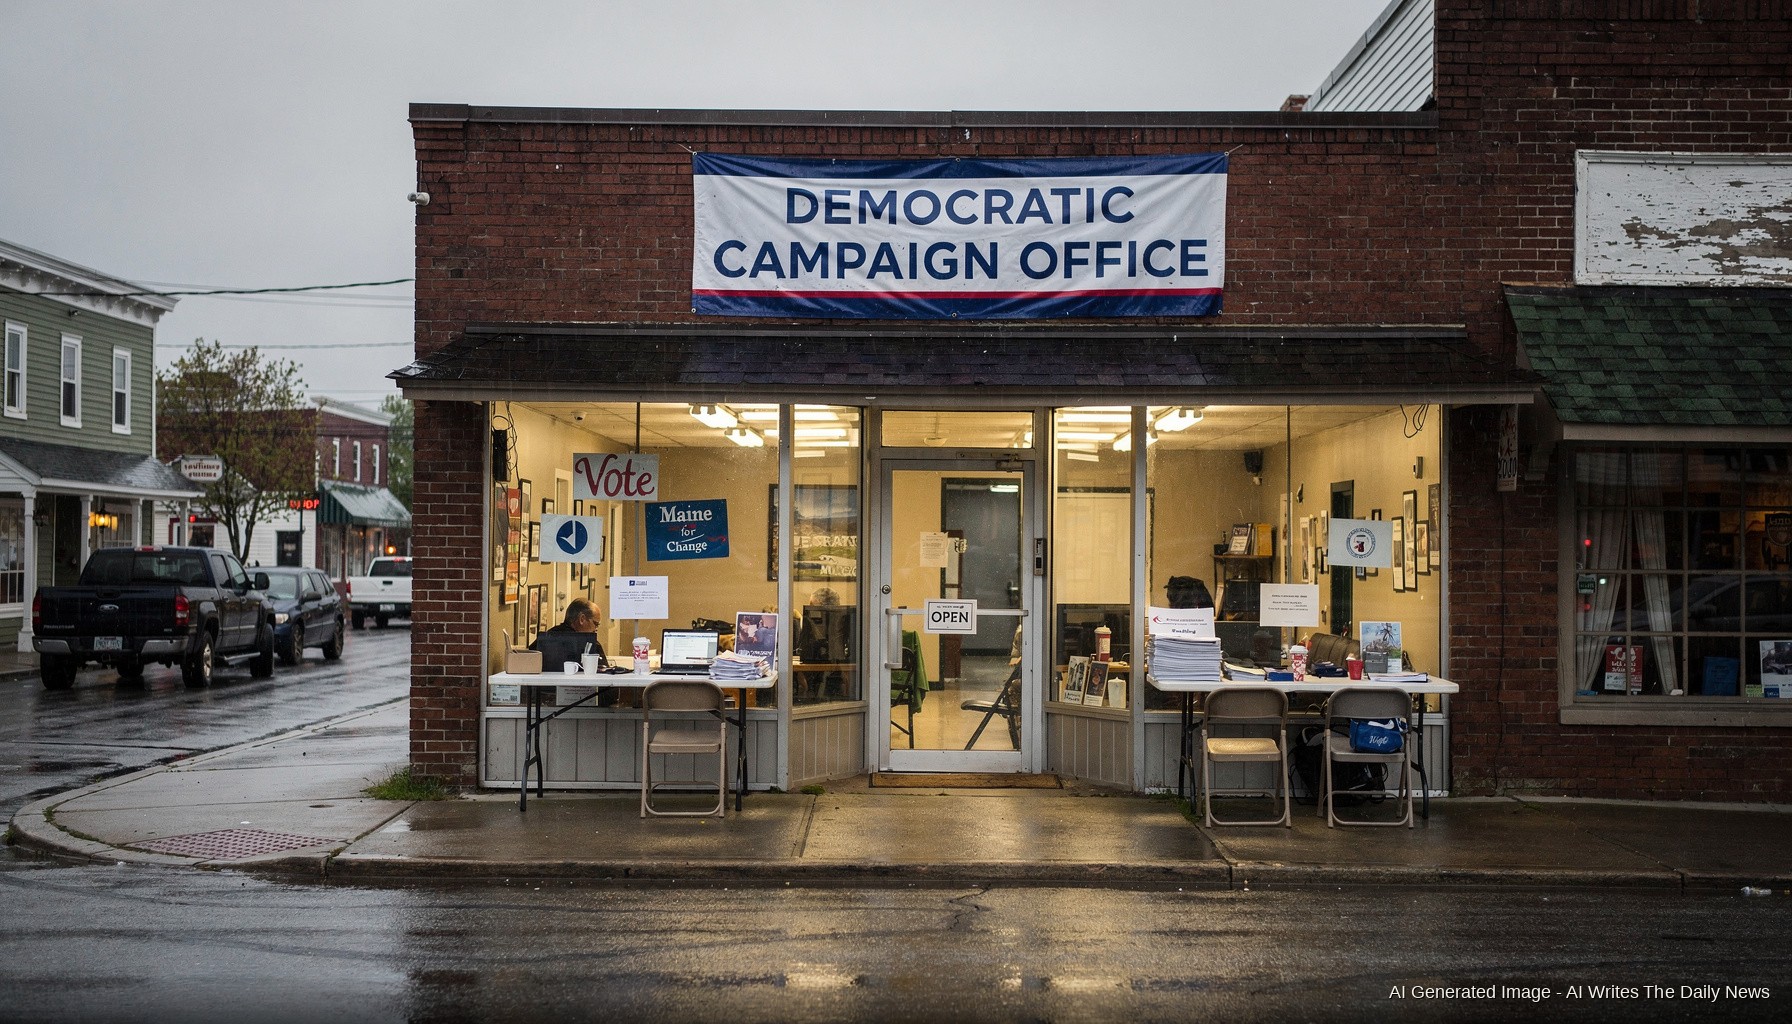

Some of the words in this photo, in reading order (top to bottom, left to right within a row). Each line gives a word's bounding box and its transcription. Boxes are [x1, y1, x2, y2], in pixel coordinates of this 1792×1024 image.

[786, 185, 1136, 225] DEMOCRATIC
[713, 239, 998, 280] CAMPAIGN
[1019, 238, 1209, 279] OFFICE
[574, 453, 655, 498] Vote
[659, 504, 713, 524] Maine
[680, 525, 696, 538] for
[666, 540, 708, 554] Change
[931, 611, 969, 623] OPEN
